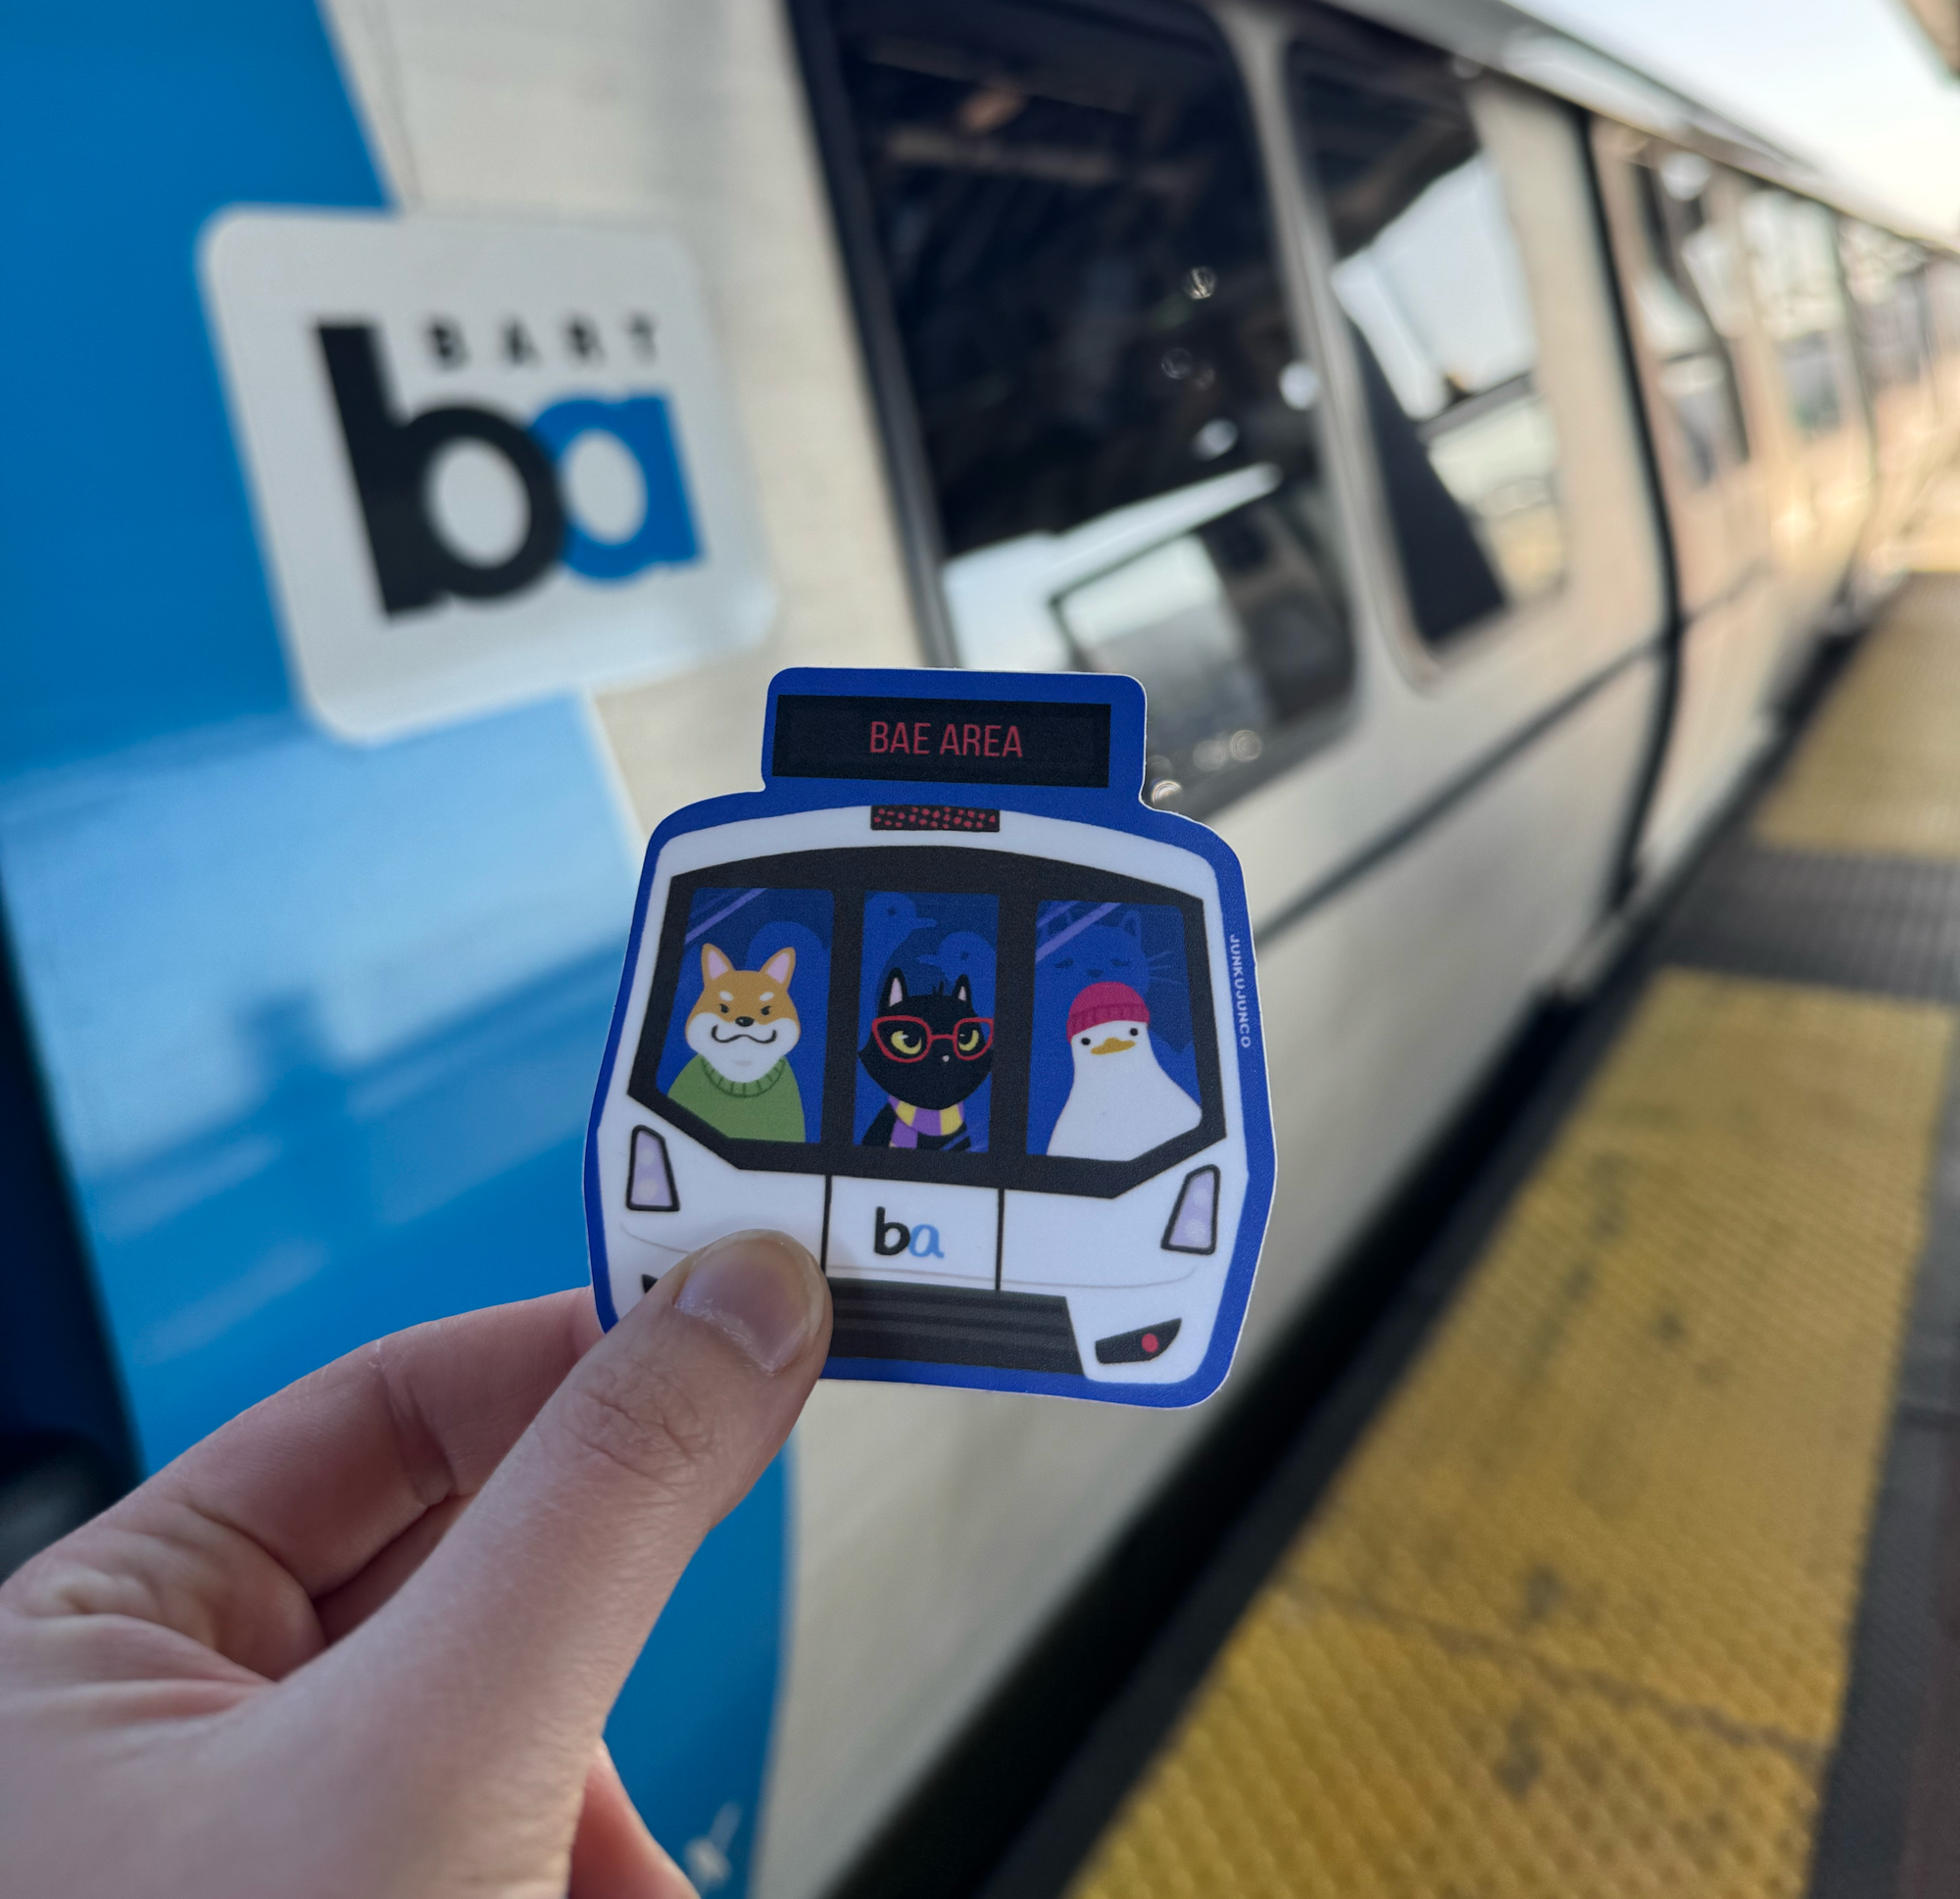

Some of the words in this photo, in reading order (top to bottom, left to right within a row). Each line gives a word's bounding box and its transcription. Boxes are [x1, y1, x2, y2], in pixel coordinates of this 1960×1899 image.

[424, 309, 658, 371] BART
[312, 317, 708, 623] ba
[869, 721, 931, 755] BAE
[939, 723, 1023, 758] AREA
[1230, 934, 1251, 1048] JUNKUJUNCO
[873, 1206, 945, 1259] ba
